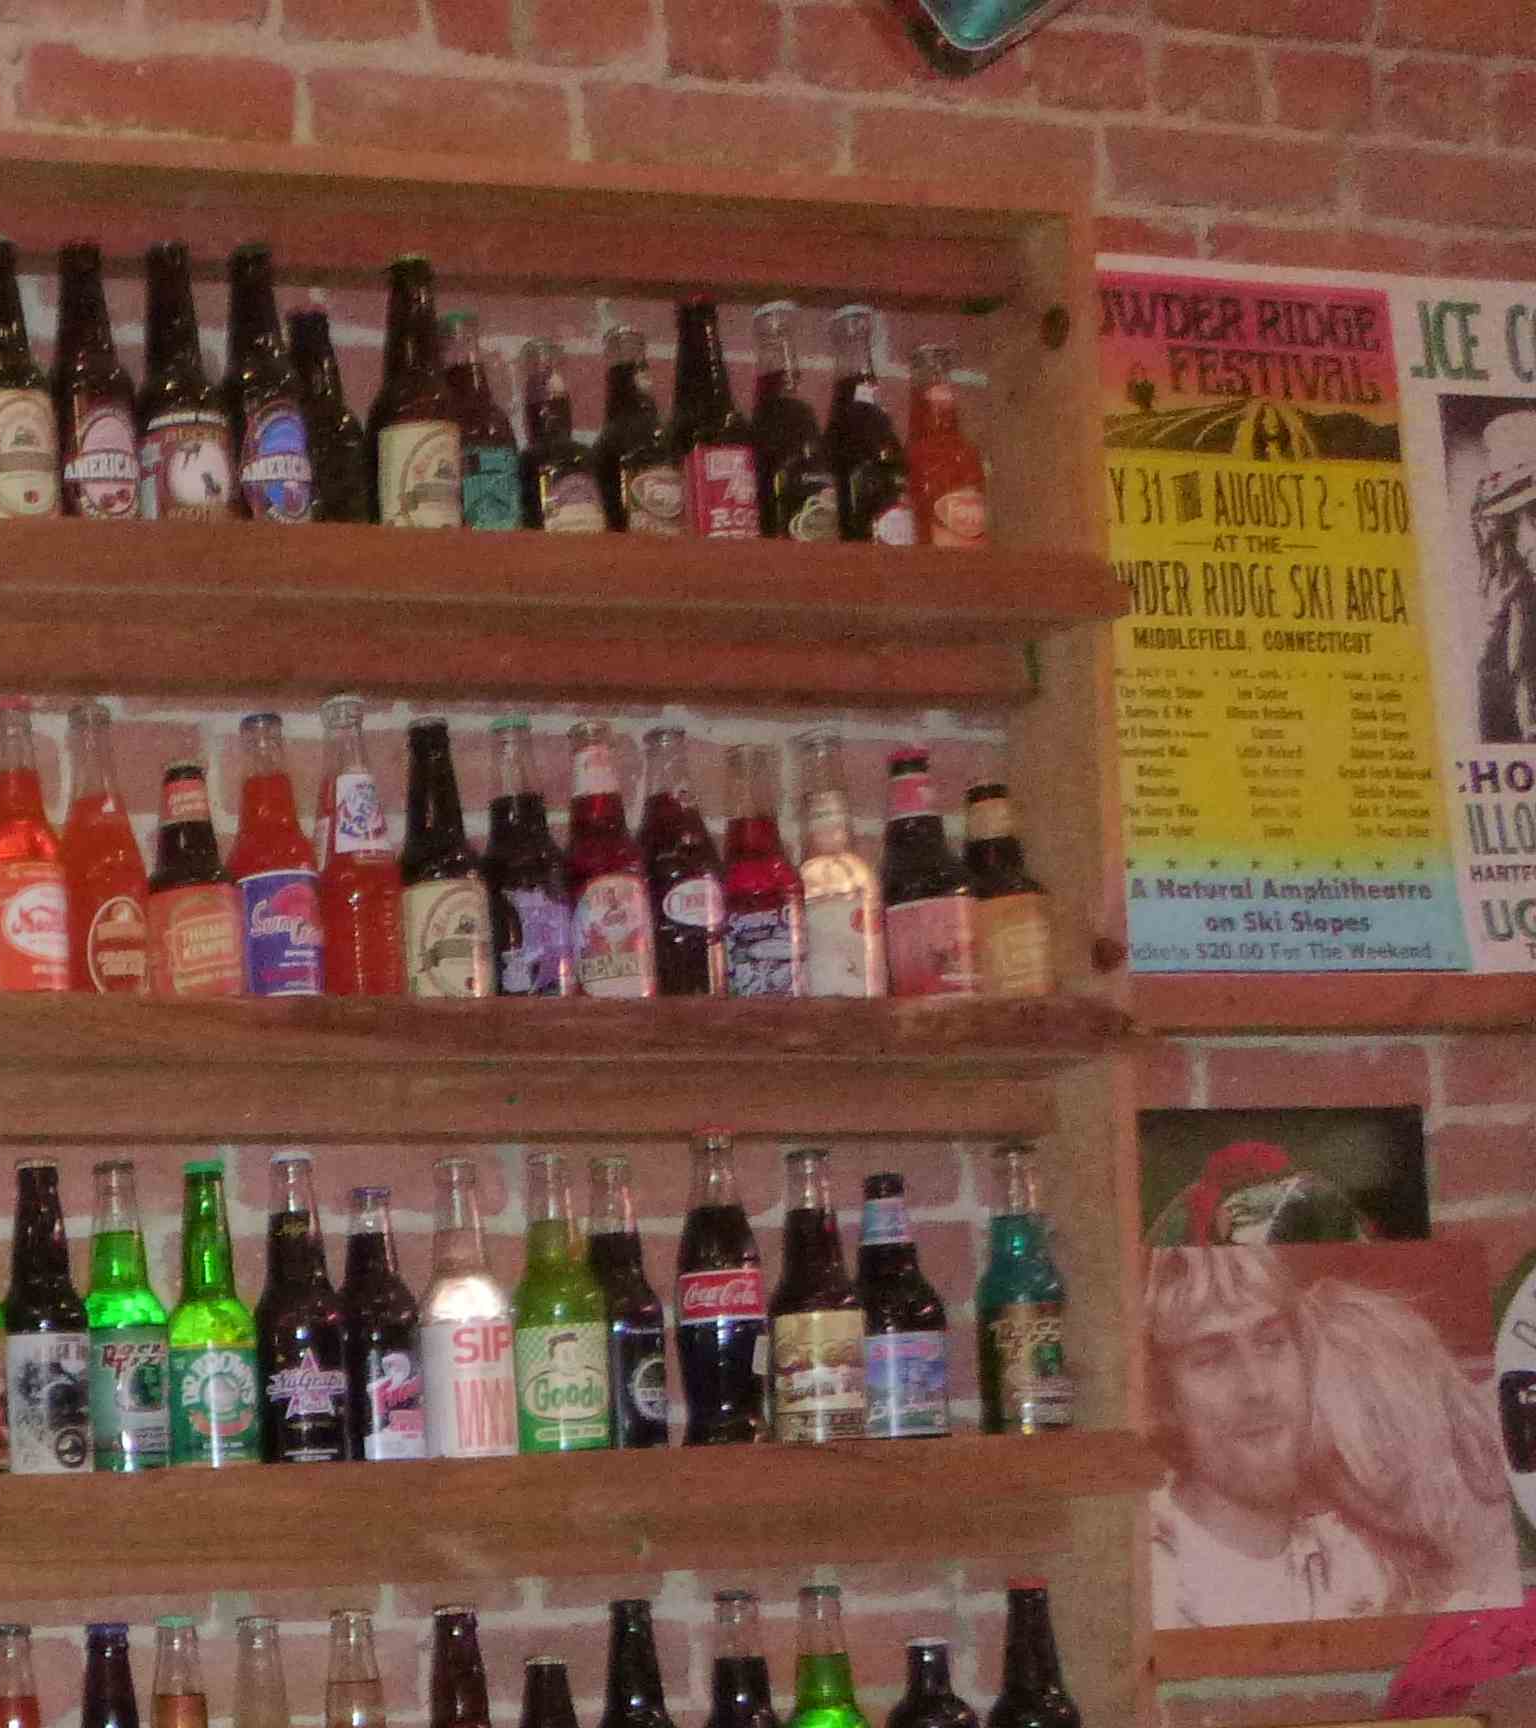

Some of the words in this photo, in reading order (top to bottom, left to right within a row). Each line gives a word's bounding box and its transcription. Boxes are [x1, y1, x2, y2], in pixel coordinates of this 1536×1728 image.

[1213, 470, 1304, 529] AUGUST
[1354, 478, 1410, 534] 1970
[1213, 536, 1239, 553] AT
[1245, 535, 1282, 554] THE
[1202, 561, 1282, 619] RIDGE
[1289, 564, 1337, 620] SKI
[1345, 565, 1409, 625] AREA
[1156, 878, 1252, 900] Natural
[1263, 878, 1433, 904] Amphitheatre
[1242, 911, 1283, 932] Ski
[1291, 911, 1372, 936] Slopes
